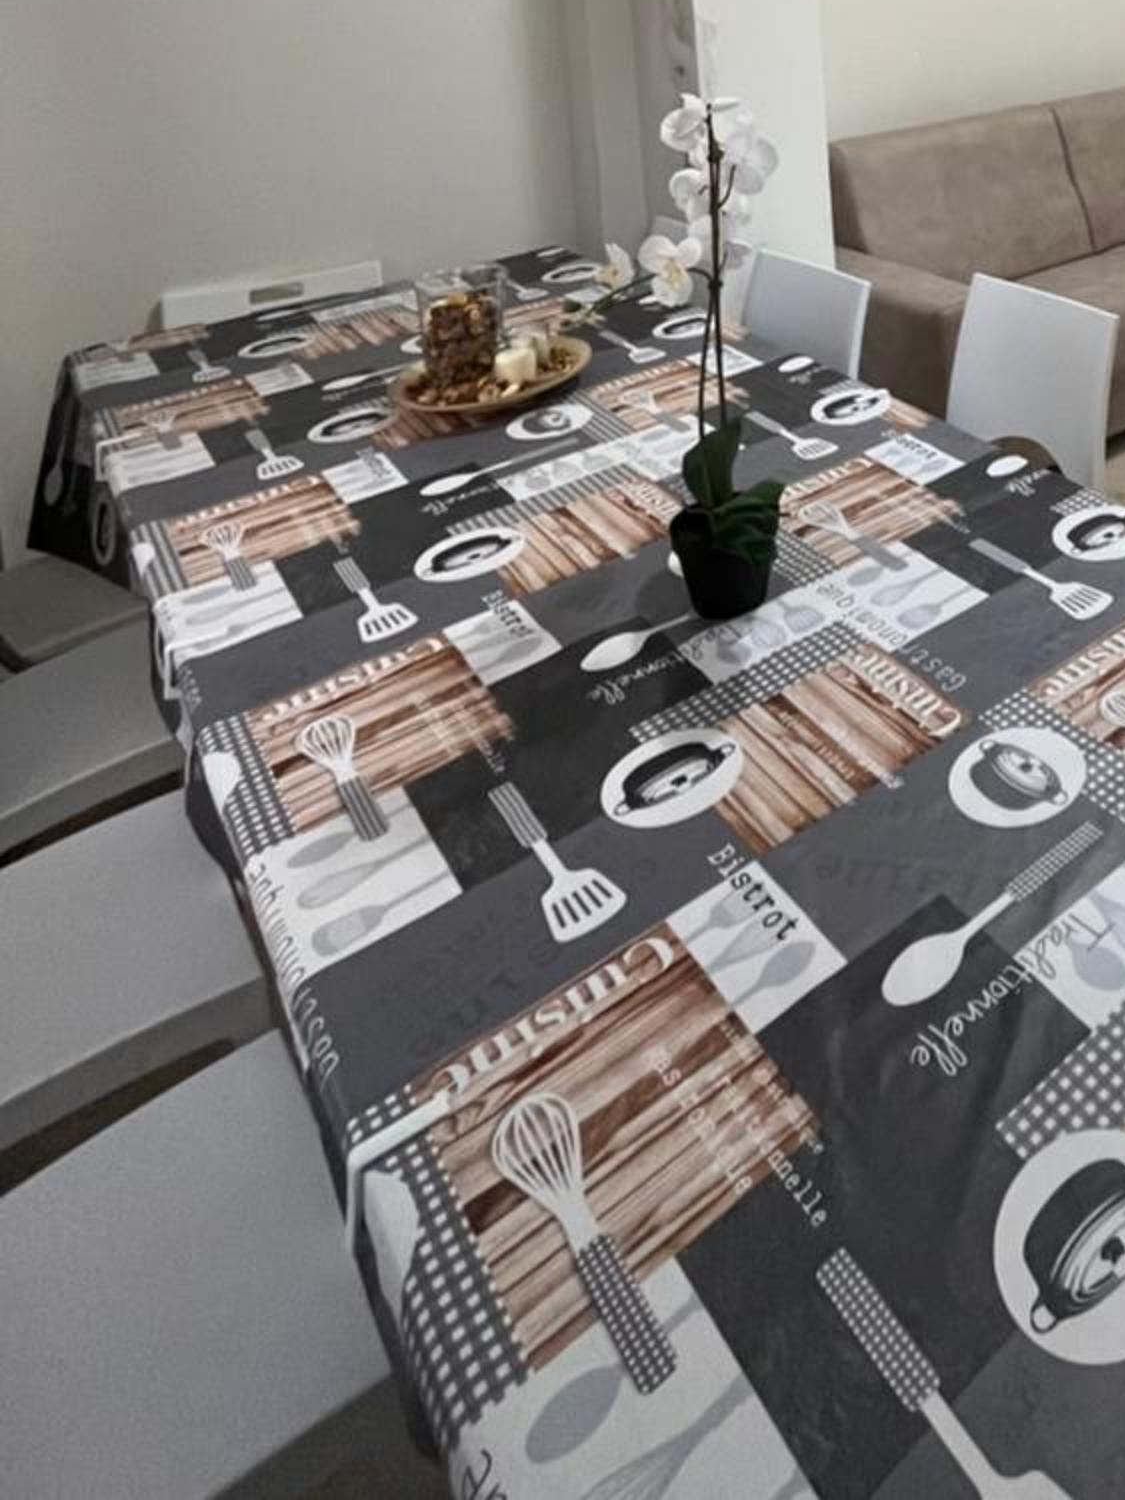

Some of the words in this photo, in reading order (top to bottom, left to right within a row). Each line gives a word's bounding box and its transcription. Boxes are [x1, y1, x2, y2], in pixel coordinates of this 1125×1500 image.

[705, 842, 801, 942] Bistrot
[430, 934, 677, 1102] Cuisine
[909, 912, 1115, 1076] Traditionnelle
